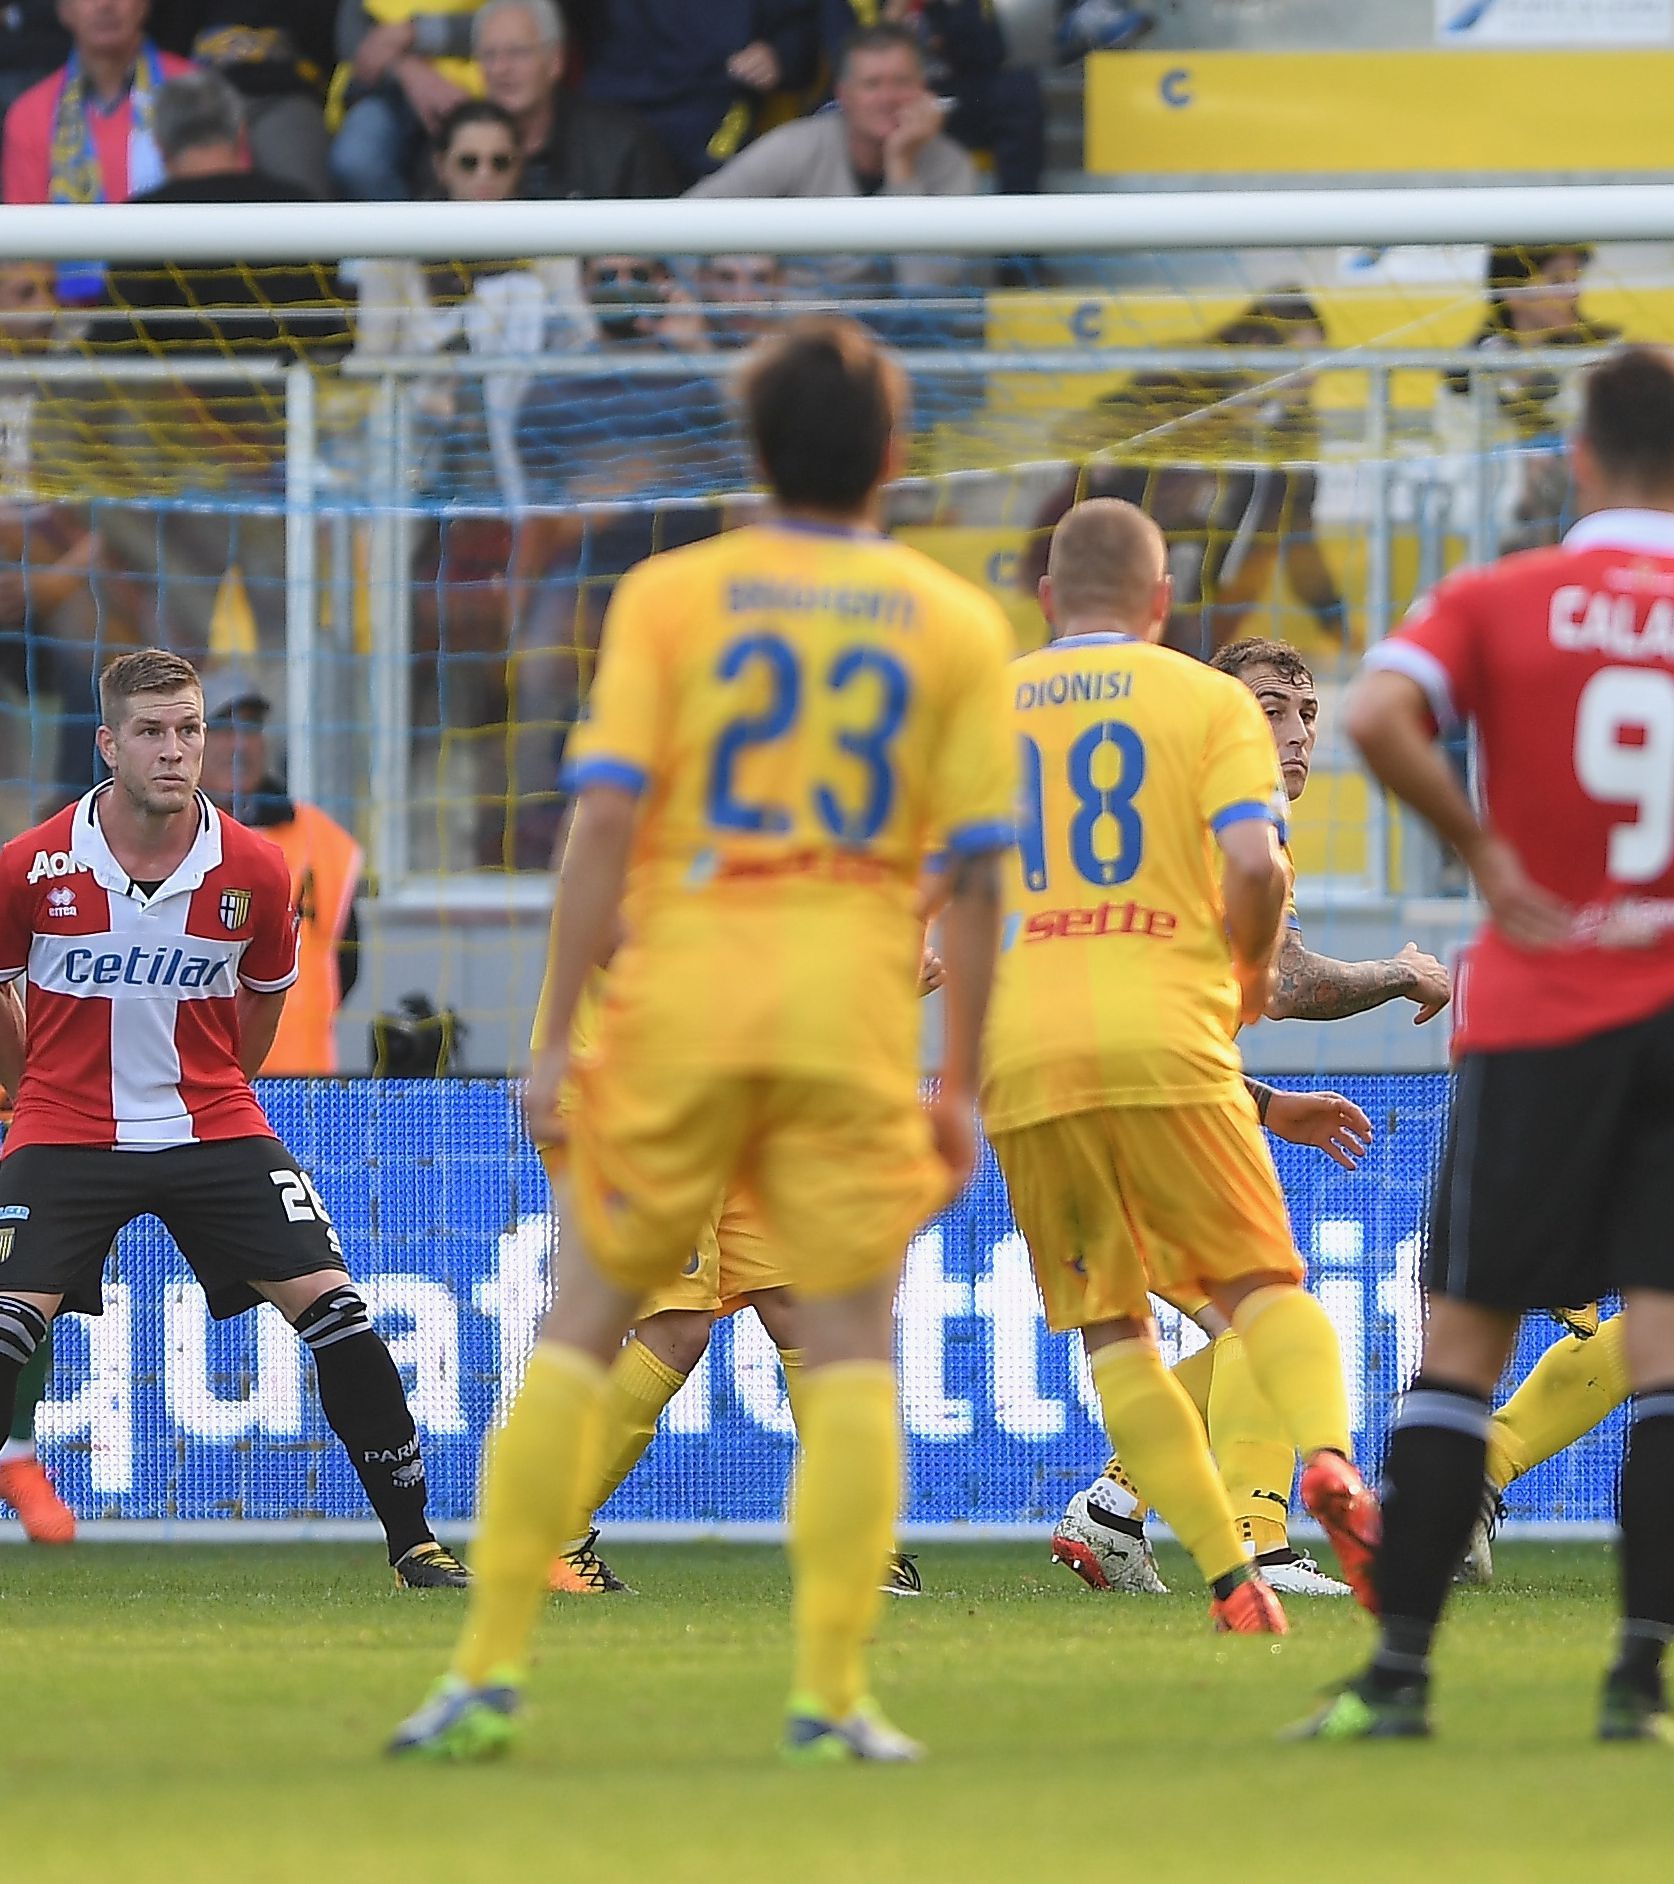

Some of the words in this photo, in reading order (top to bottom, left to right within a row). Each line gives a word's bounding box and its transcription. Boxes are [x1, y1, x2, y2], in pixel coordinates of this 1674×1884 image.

[1160, 68, 1191, 108] C
[1069, 302, 1101, 338] C
[1016, 671, 1134, 710] DIONISI
[708, 632, 912, 841] 23
[1016, 718, 1146, 891] 18
[1025, 901, 1177, 943] sette
[65, 946, 233, 988] Cetilar
[364, 1433, 420, 1463] PARM
